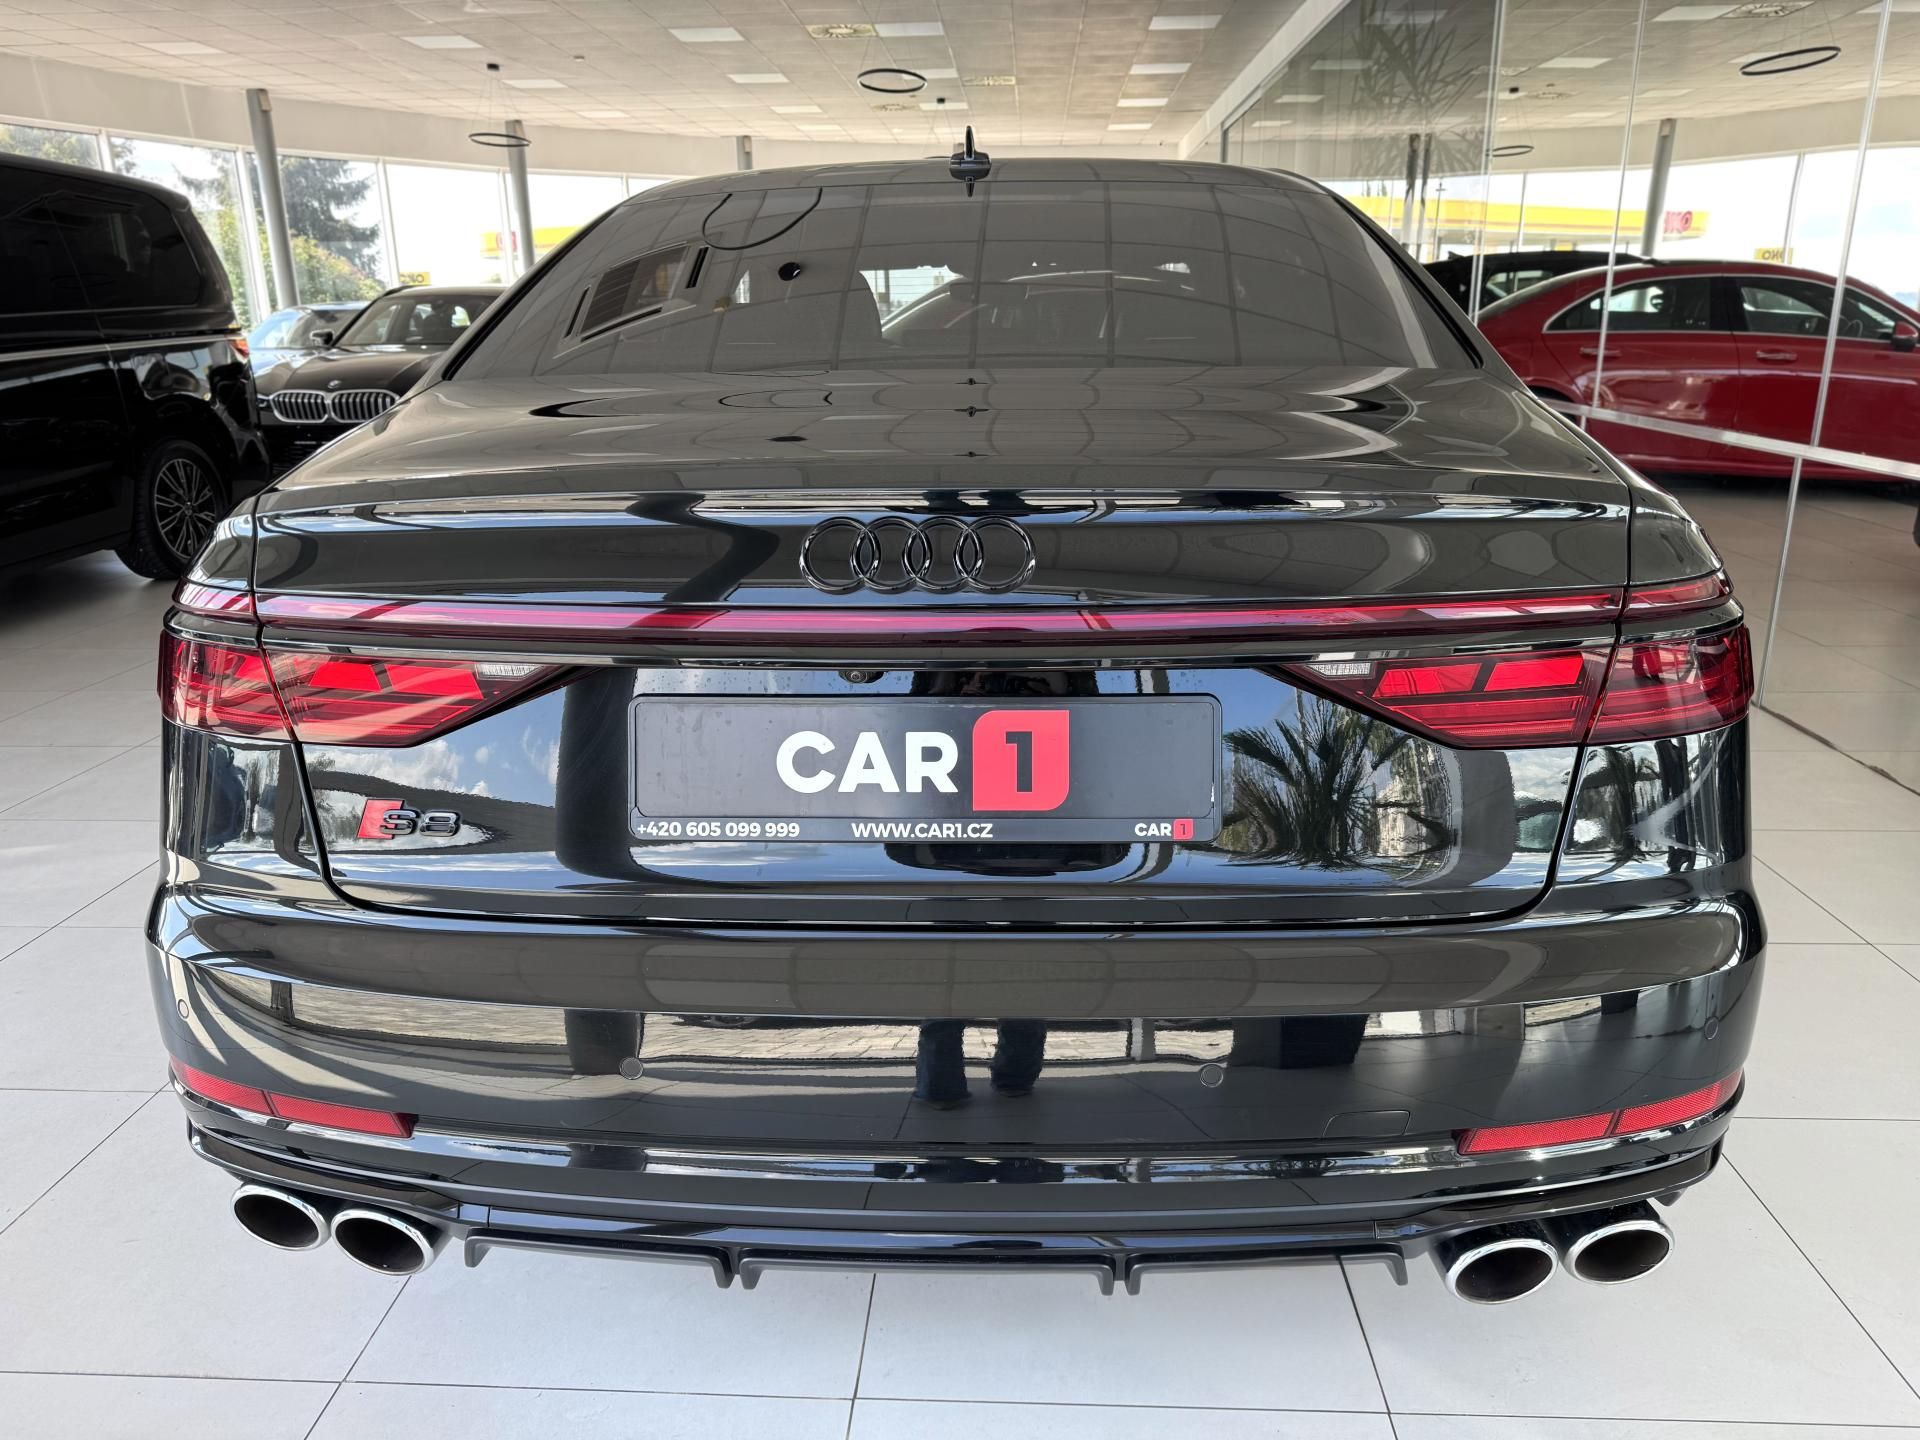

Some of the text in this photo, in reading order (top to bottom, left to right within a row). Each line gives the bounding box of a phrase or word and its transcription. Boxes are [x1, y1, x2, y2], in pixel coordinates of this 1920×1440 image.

[776, 730, 1033, 794] CAR 1
[379, 808, 461, 837] S8
[637, 821, 800, 837] +420 605 099 999
[851, 822, 994, 838] WWW.CAR1.CZ
[1134, 822, 1172, 837] CAR
